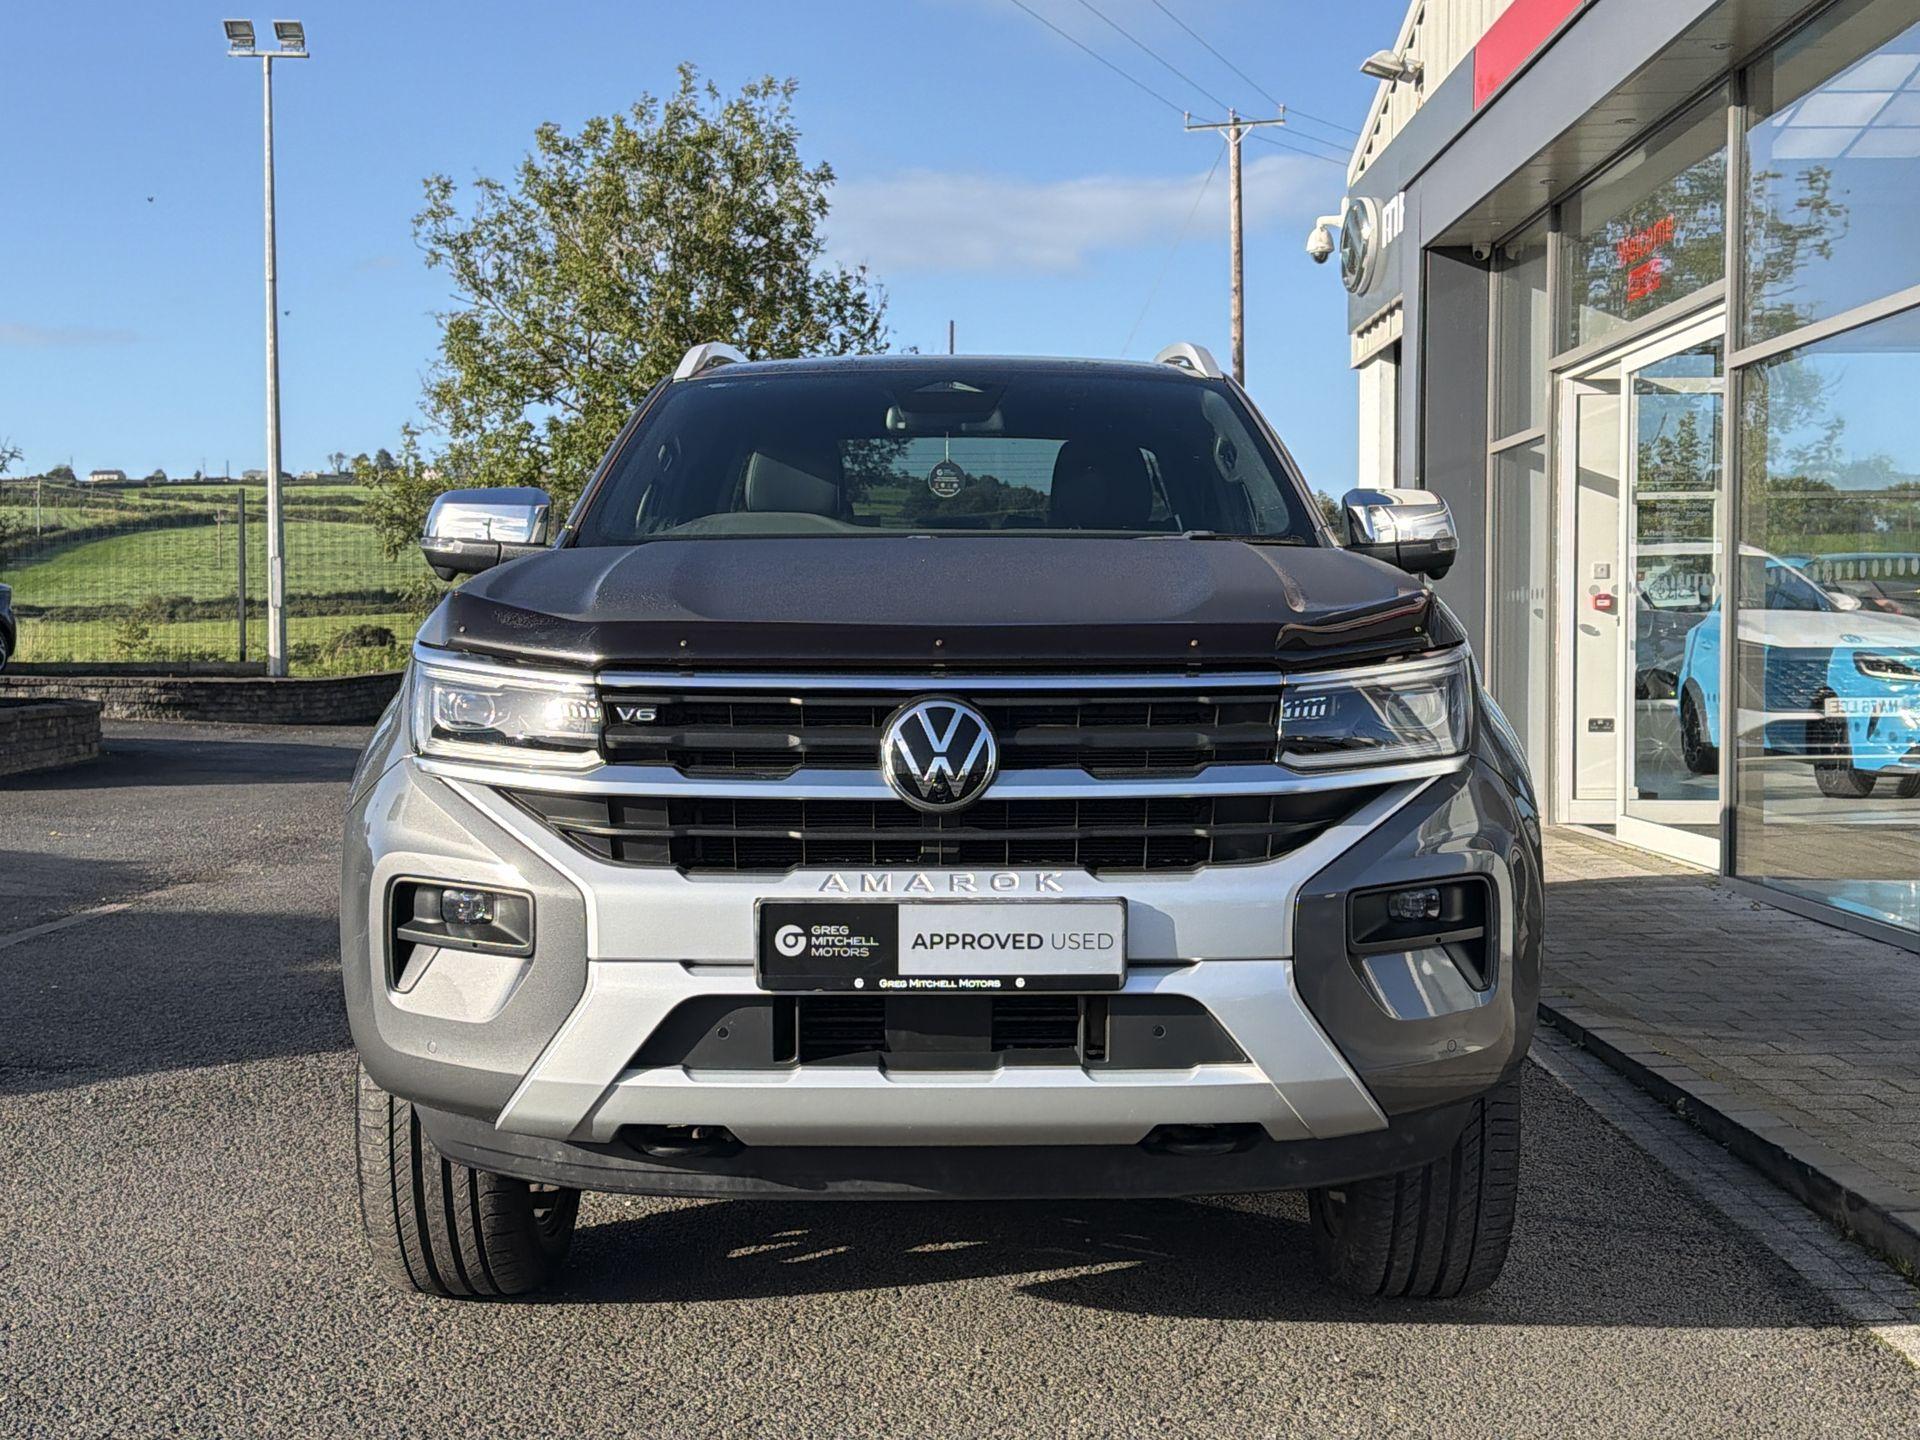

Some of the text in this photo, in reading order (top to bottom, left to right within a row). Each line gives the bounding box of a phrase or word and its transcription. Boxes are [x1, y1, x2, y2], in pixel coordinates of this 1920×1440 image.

[615, 706, 658, 722] V6
[818, 872, 1064, 893] AMAROK
[811, 925, 850, 935] GREG
[811, 936, 880, 946] MITCHELL
[911, 933, 1114, 950] APPROVED USED
[811, 947, 870, 957] MOTORS
